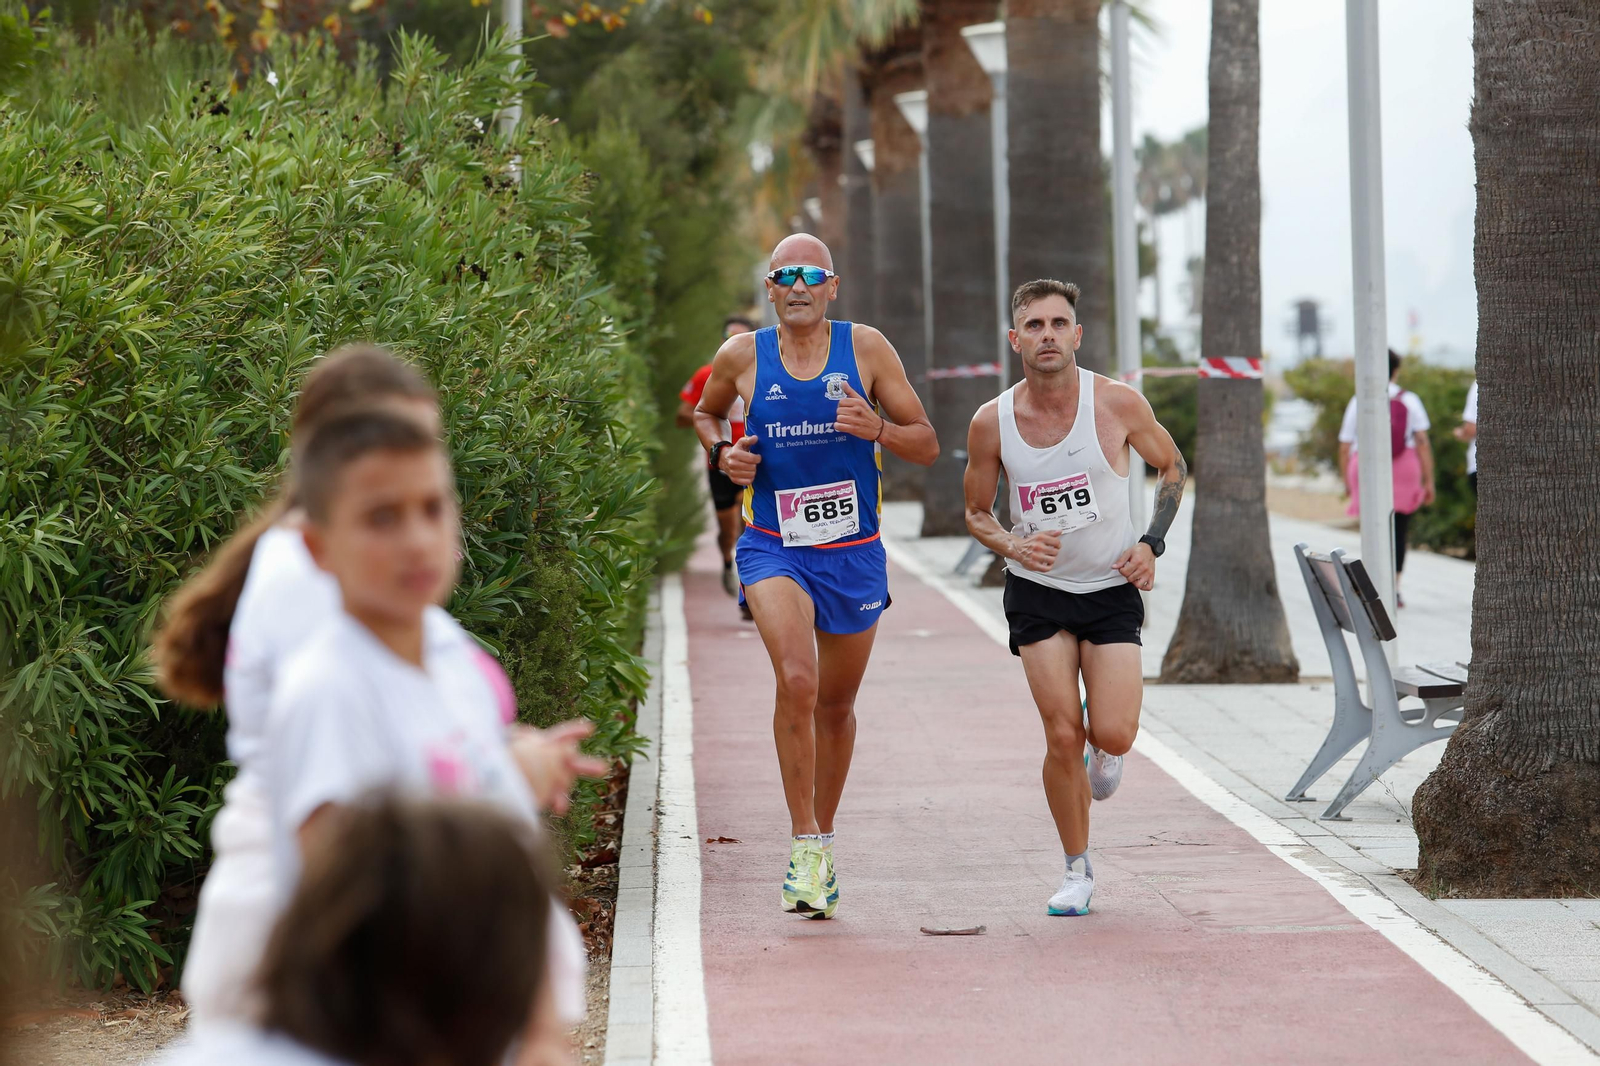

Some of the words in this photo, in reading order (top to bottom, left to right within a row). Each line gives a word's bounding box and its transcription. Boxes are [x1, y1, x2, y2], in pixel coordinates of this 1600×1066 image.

[765, 420, 840, 438] Tirabuz
[804, 497, 854, 523] 685
[1040, 488, 1091, 515] 619
